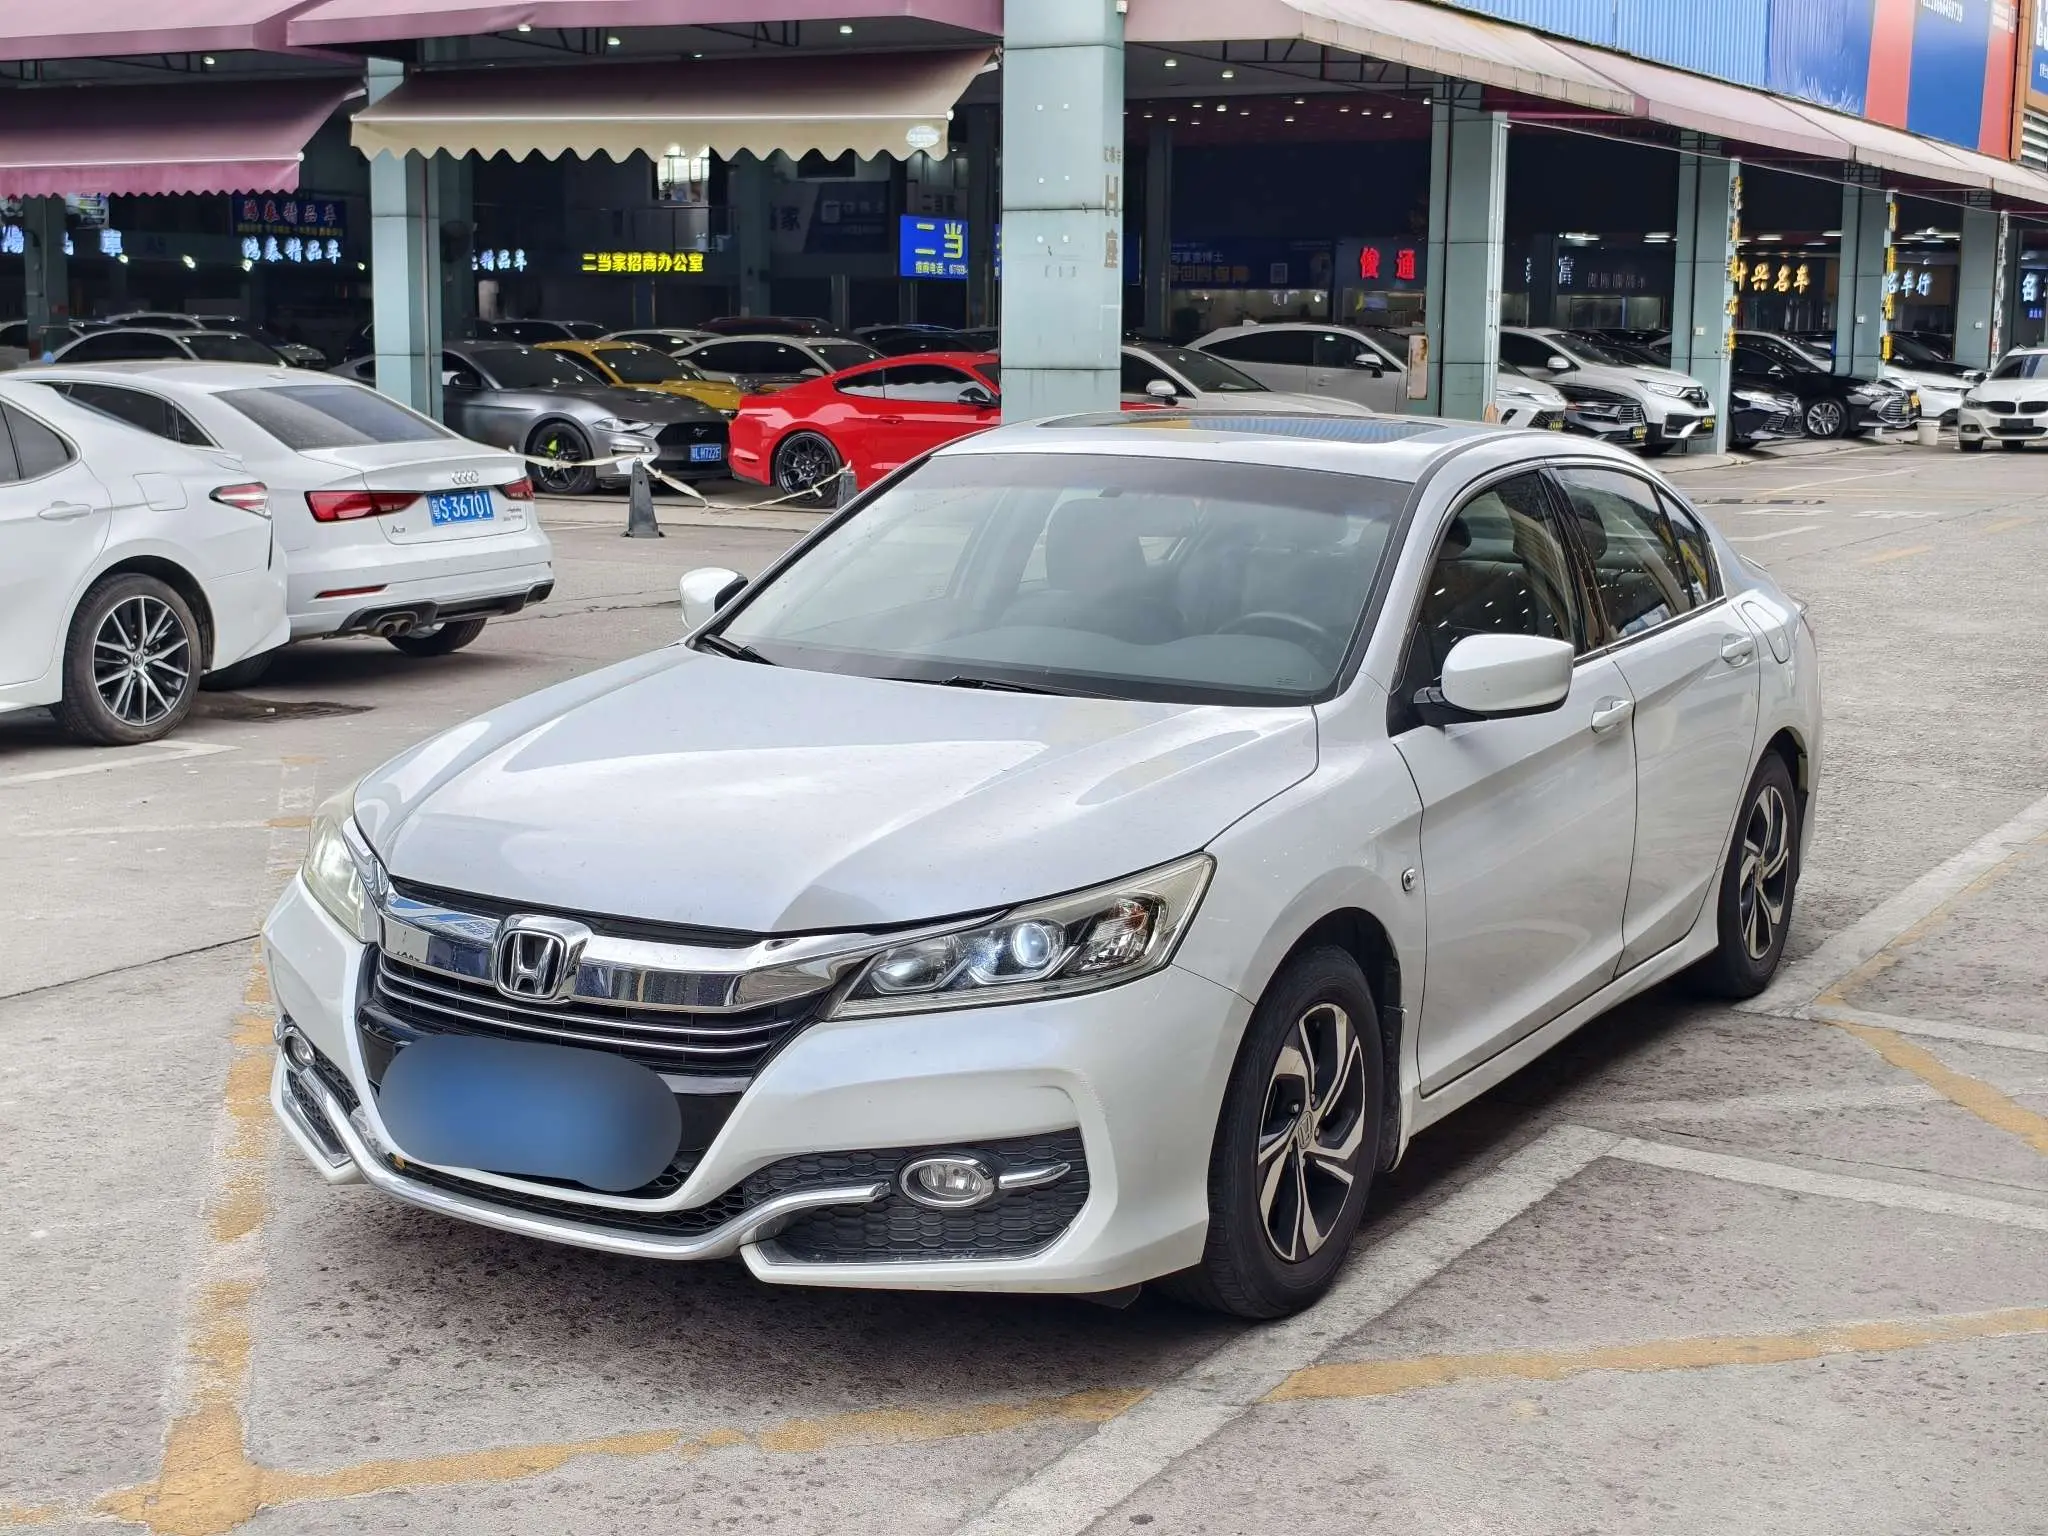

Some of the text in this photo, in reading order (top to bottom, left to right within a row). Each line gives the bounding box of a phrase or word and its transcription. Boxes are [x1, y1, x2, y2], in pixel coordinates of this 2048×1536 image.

[914, 222, 964, 259] 二当
[581, 252, 704, 273] 二当家招商办公室
